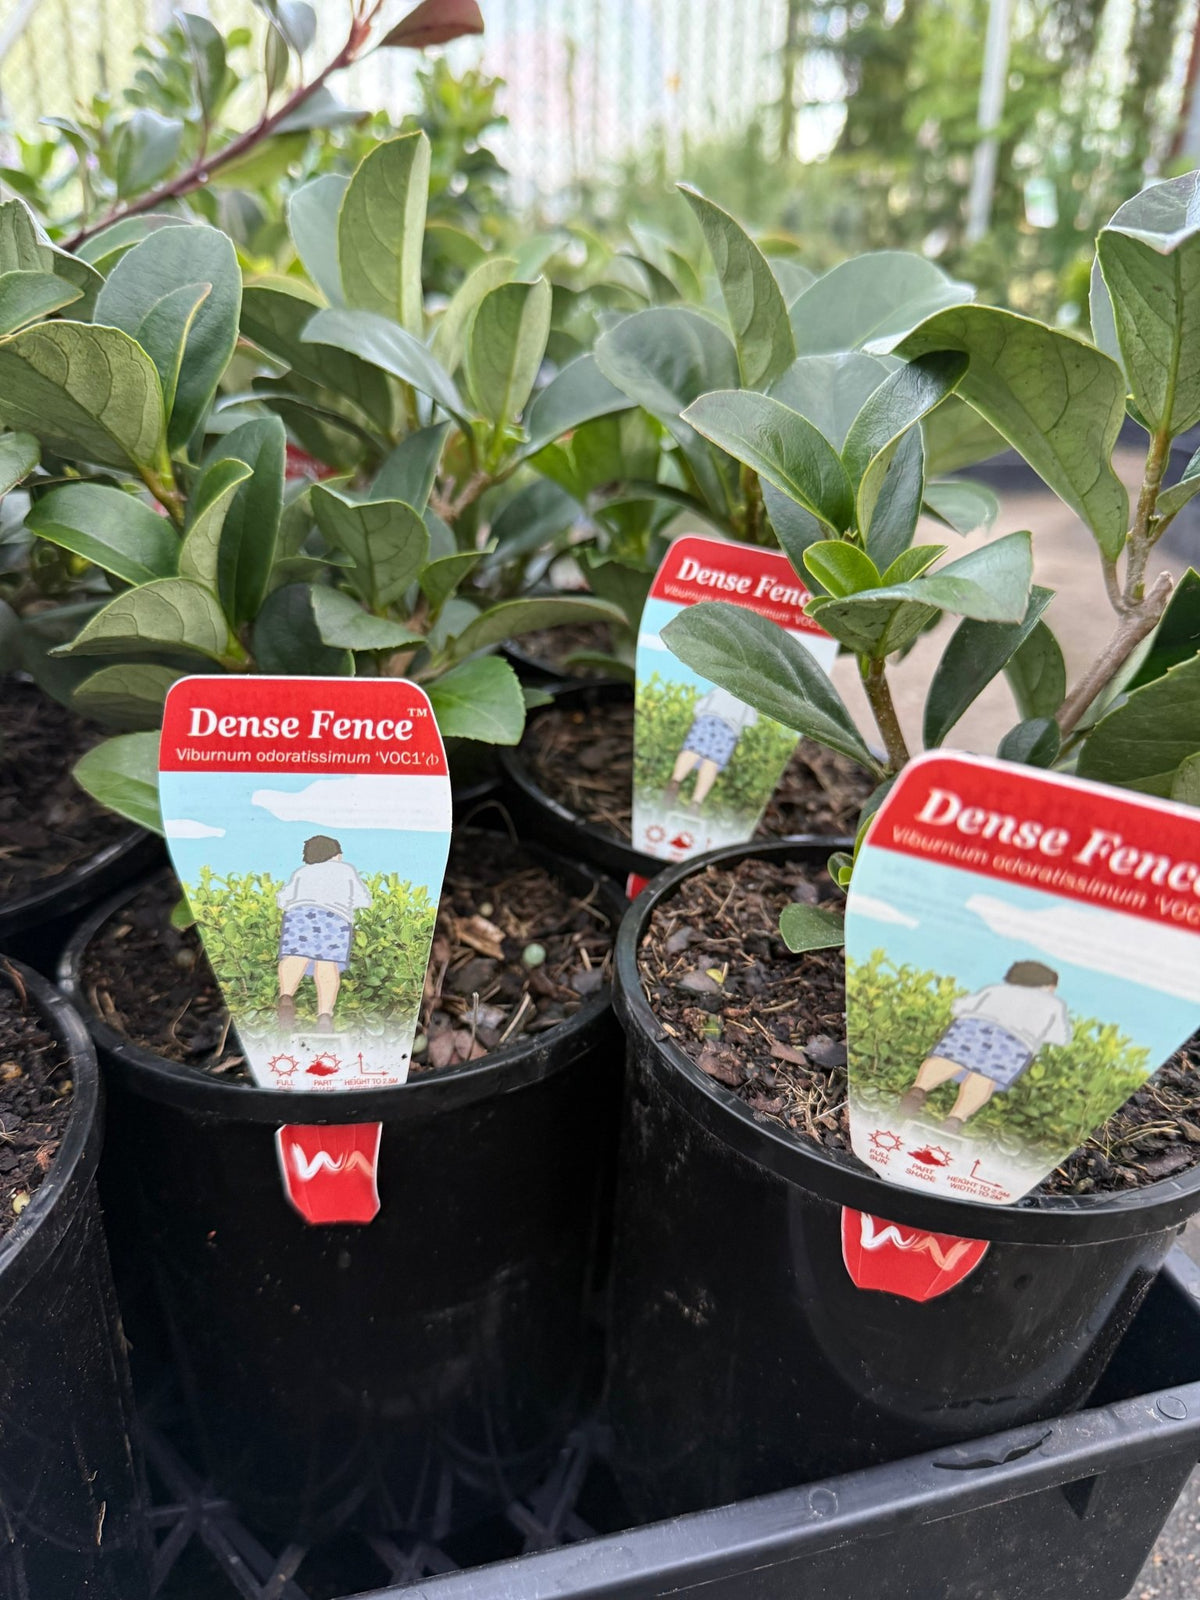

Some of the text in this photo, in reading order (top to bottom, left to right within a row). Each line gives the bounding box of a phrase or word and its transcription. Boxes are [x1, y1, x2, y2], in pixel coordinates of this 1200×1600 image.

[676, 557, 816, 607] Dense Fenc
[187, 707, 299, 738] Dense
[176, 747, 251, 762] Viburnum
[256, 749, 371, 765] odoratissimum
[914, 787, 1070, 857] Dense
[892, 825, 990, 865] Viburnum
[992, 854, 1148, 910] odoratissimum
[344, 1078, 370, 1086] HEIGHT
[869, 1148, 890, 1160] FULL
[869, 1154, 888, 1165] SUN
[905, 1168, 937, 1183] SHADE
[911, 1163, 936, 1175] PART
[947, 1175, 978, 1188] HEIGHT
[950, 1183, 977, 1196] WIDTH
